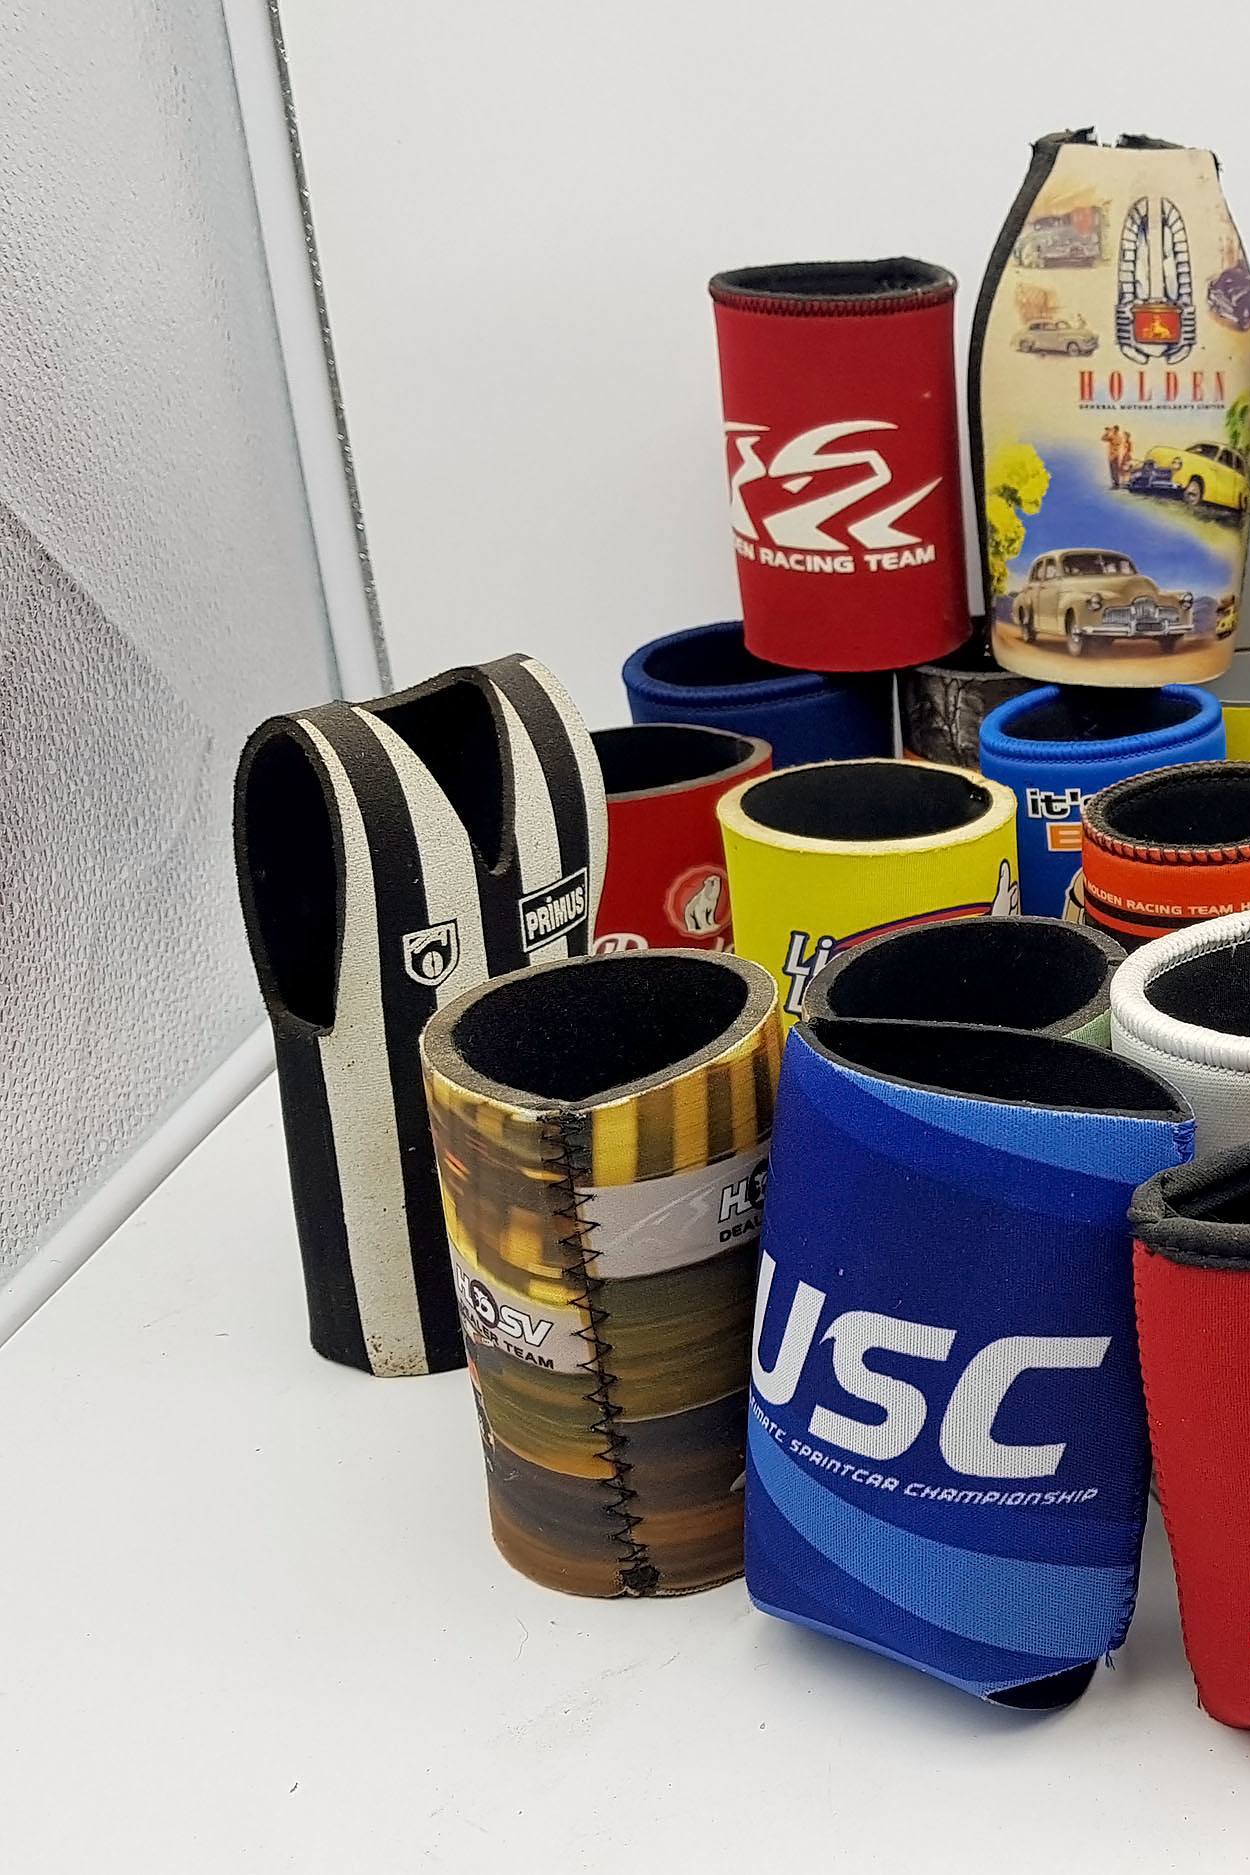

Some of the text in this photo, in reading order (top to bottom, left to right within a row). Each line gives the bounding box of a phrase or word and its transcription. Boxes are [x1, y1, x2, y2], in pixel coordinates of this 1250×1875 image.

[1079, 371, 1225, 401] HOLDEN
[759, 547, 855, 574] RACING
[864, 545, 936, 572] TEAM
[1087, 881, 1123, 906] HOLDEN
[1126, 900, 1183, 916] RACING
[1187, 904, 1234, 917] TEAM
[503, 1340, 554, 1370] TEAM
[751, 1249, 1113, 1480] USC
[749, 1388, 1099, 1507] TIMATE SPRINTCAR CHAMPIONSHIP
